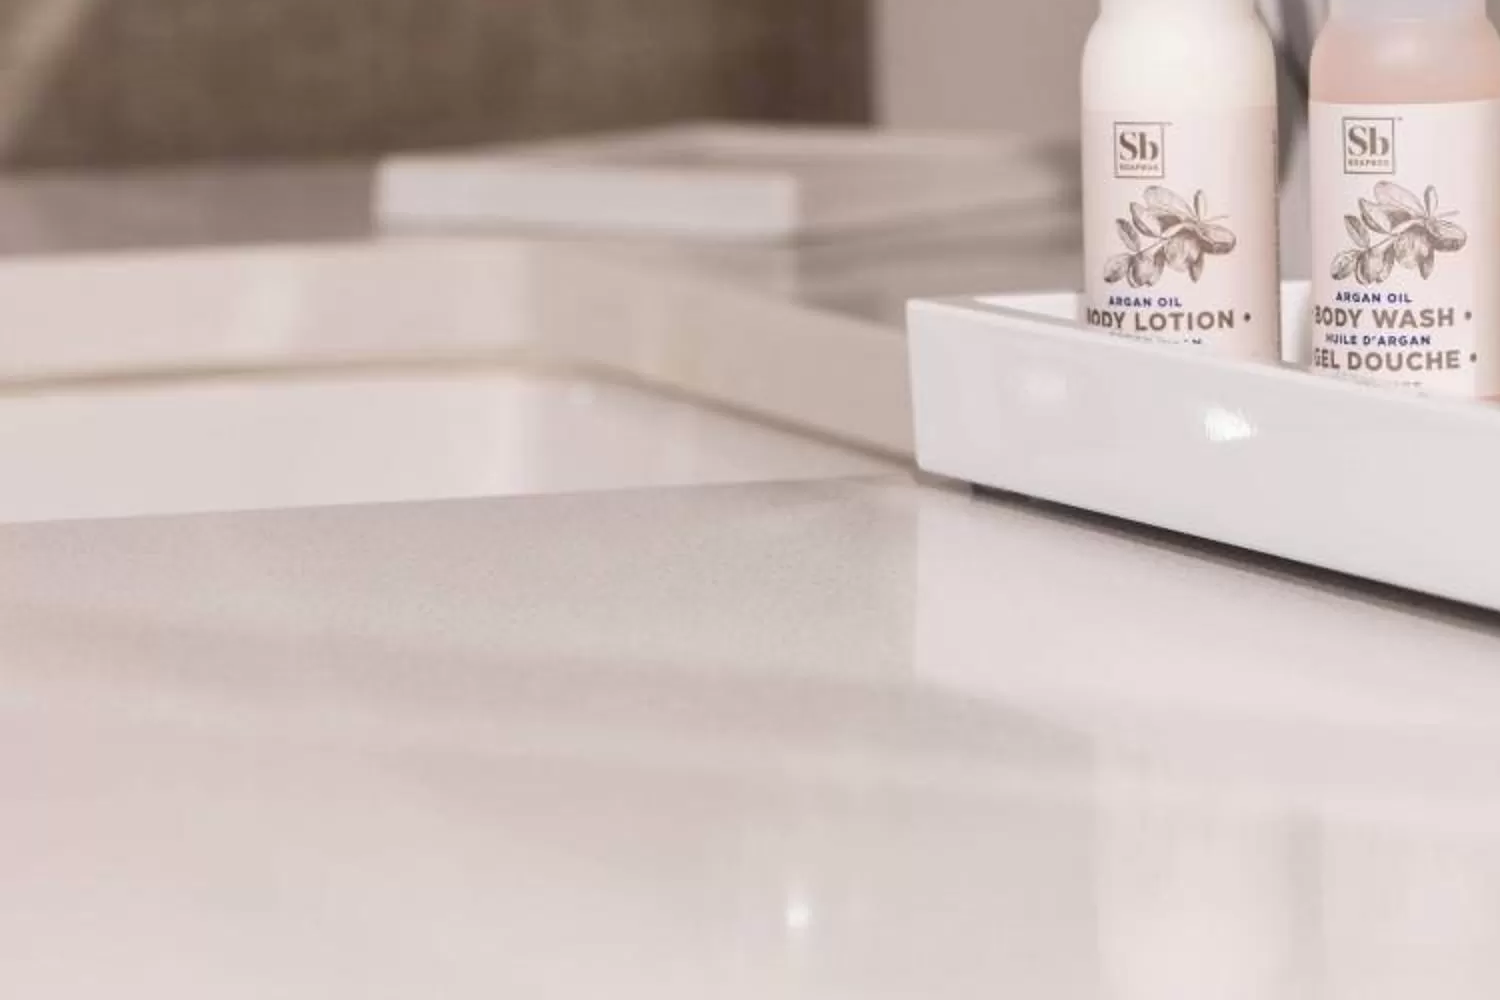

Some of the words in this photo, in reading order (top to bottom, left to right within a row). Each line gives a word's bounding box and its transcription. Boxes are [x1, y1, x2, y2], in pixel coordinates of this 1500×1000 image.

[1119, 131, 1159, 162] Sb
[1347, 125, 1389, 157] Sb
[1109, 295, 1151, 307] ARGAN
[1157, 297, 1182, 307] OIL
[1335, 292, 1381, 303] ARGAN
[1387, 293, 1412, 303] OIL
[1135, 309, 1234, 331] LOTION
[1372, 307, 1454, 329] WASH
[1325, 333, 1357, 345] HUILE
[1363, 335, 1431, 346] D'ARGAN
[1348, 350, 1461, 371] DOUCHE
